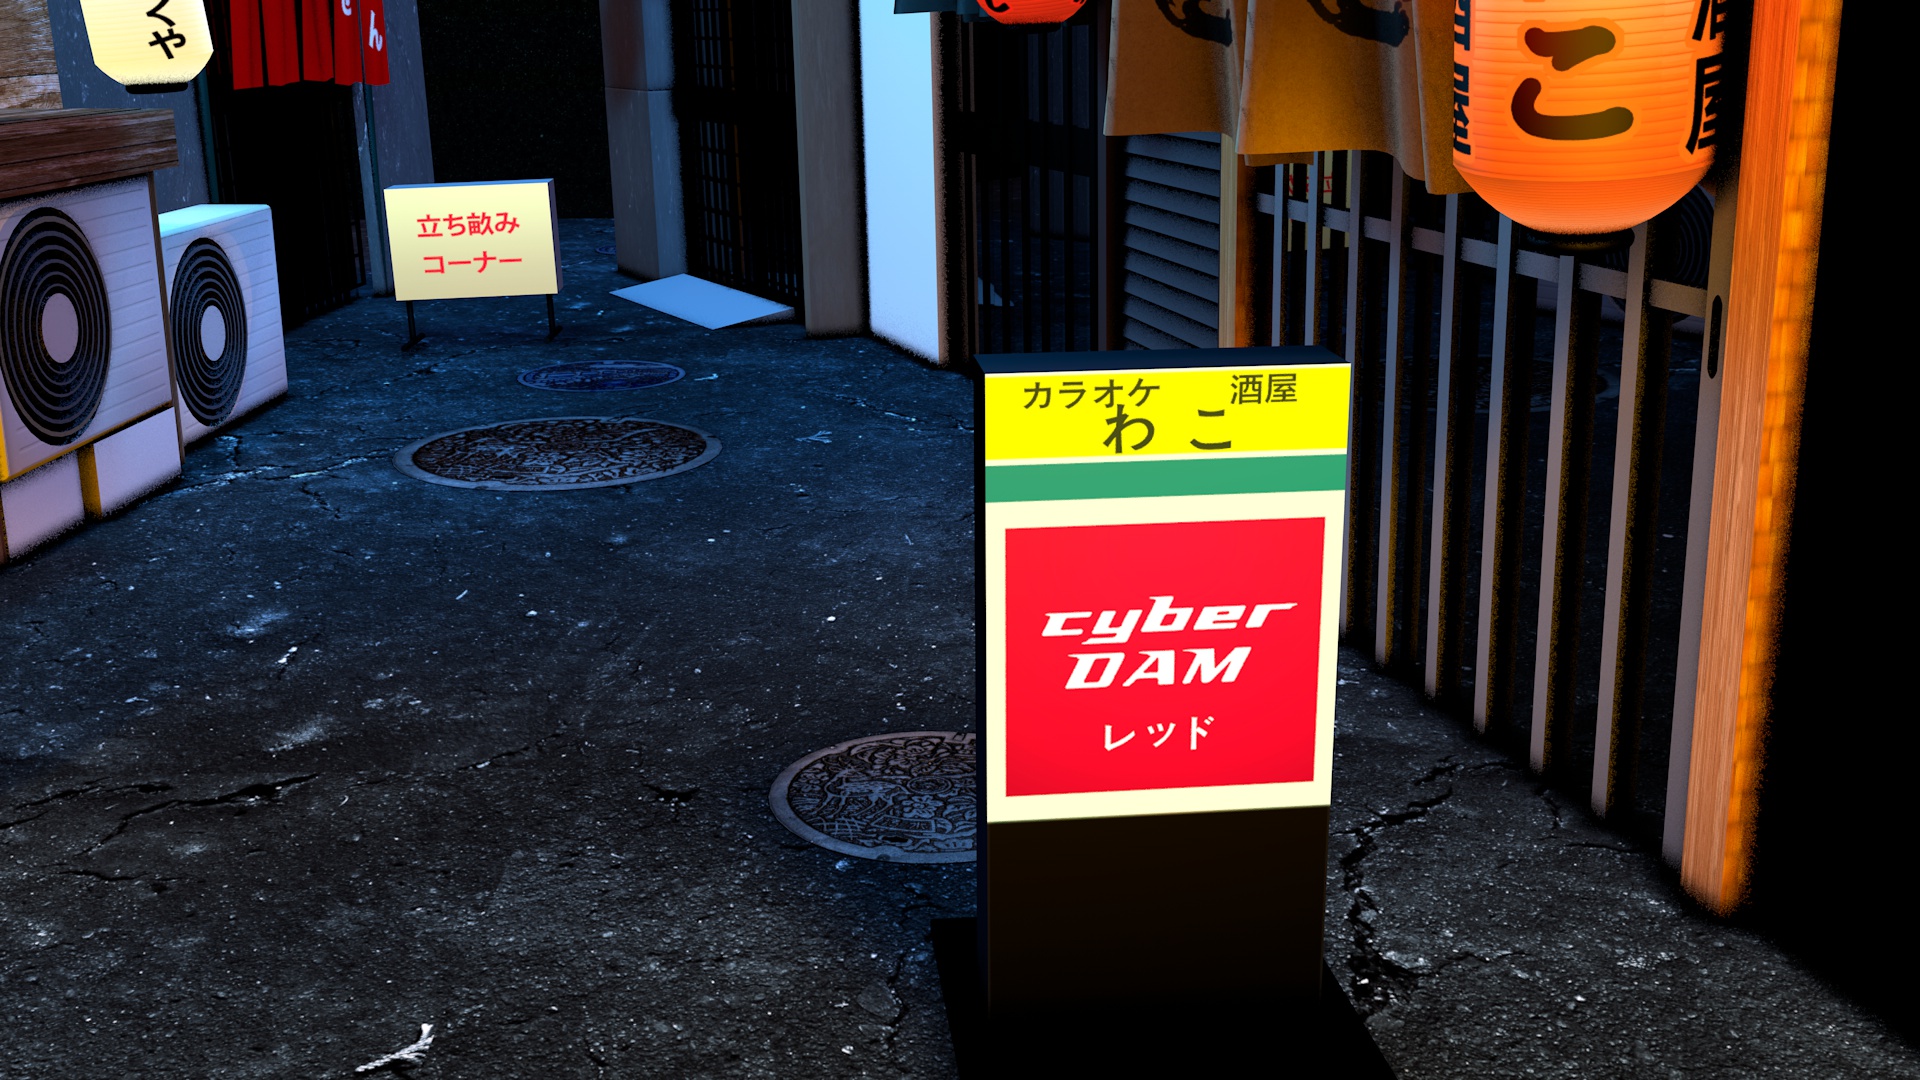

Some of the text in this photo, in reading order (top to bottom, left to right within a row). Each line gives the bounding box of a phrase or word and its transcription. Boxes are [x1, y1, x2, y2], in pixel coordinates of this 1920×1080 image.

[1511, 25, 1634, 141] こ
[423, 250, 522, 274] コーナー
[1023, 373, 1298, 409] カラオケ 酒屋
[1041, 595, 1298, 646] cyber
[1064, 646, 1252, 690] DAM
[1103, 715, 1215, 752] レッド
